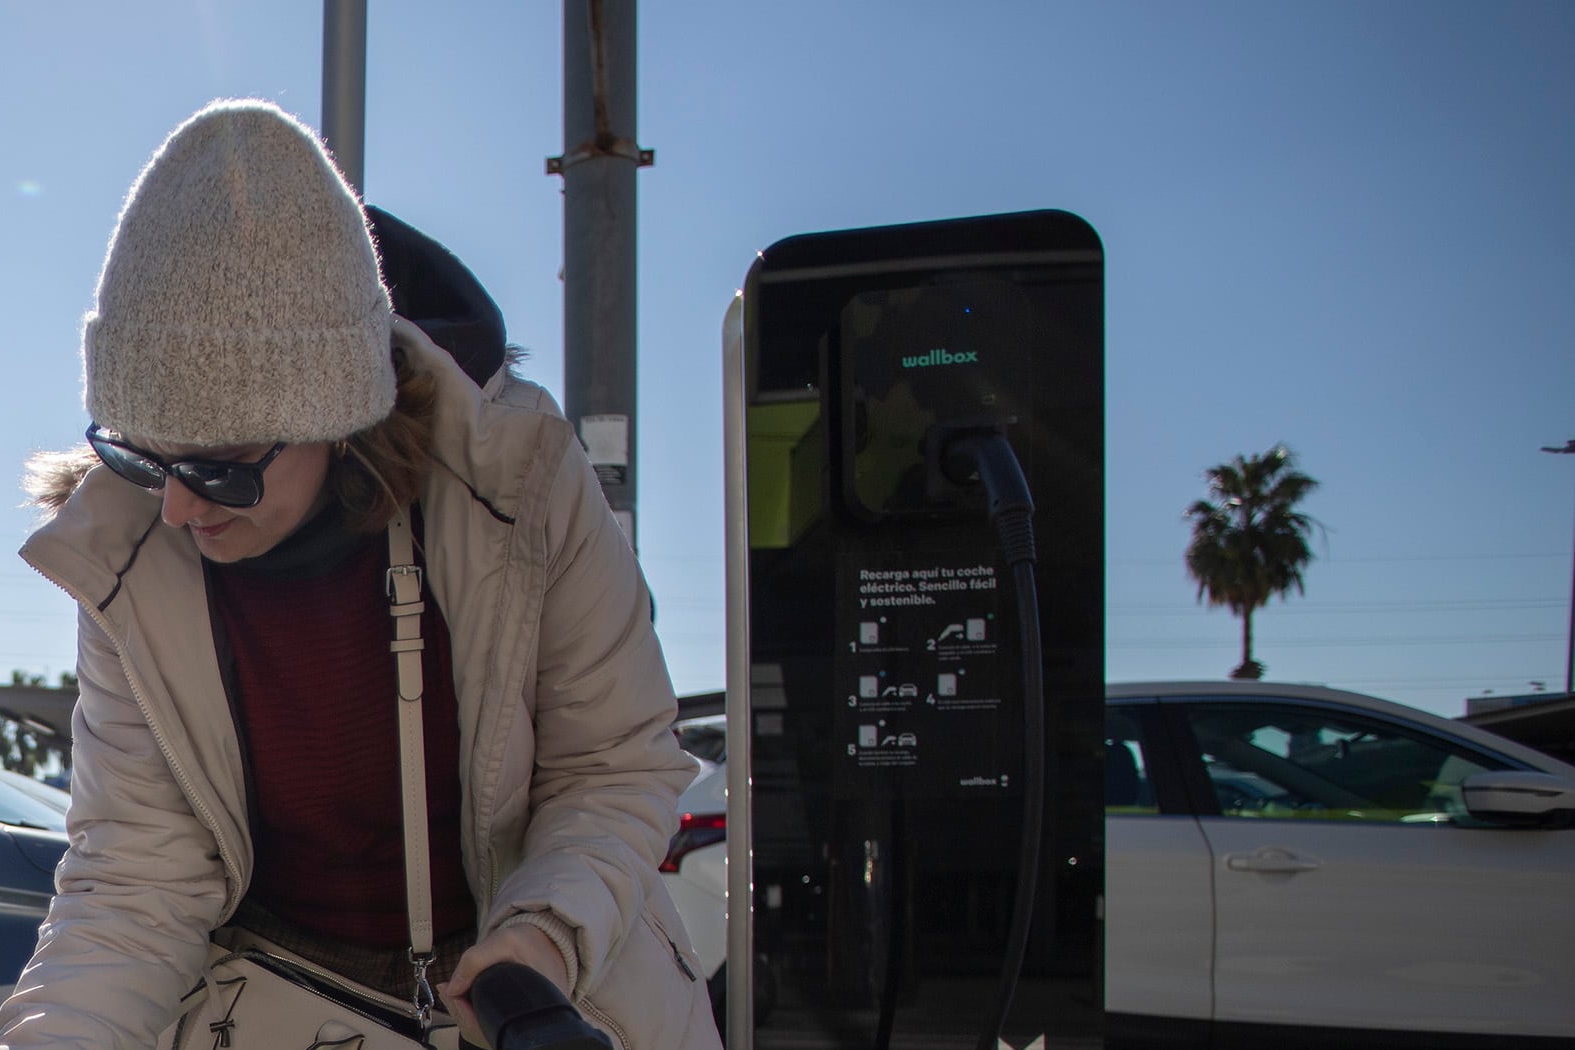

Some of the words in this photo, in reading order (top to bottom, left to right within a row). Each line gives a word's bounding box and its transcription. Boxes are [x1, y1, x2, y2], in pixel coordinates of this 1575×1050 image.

[902, 348, 977, 367] wallbox
[860, 569, 910, 581] Recarga
[912, 566, 939, 580] aquí
[941, 568, 954, 577] tu
[956, 565, 994, 576] coche
[860, 582, 916, 593] eléctrico.
[918, 579, 967, 591] Sencillo
[969, 577, 996, 589] fácil
[859, 597, 867, 609] y
[870, 594, 936, 606] sostenible.
[849, 641, 857, 653] 1
[926, 638, 936, 651] 2
[848, 695, 857, 707] 3
[926, 693, 936, 705] 4
[847, 744, 856, 755] 5
[959, 776, 997, 787] wallbox
